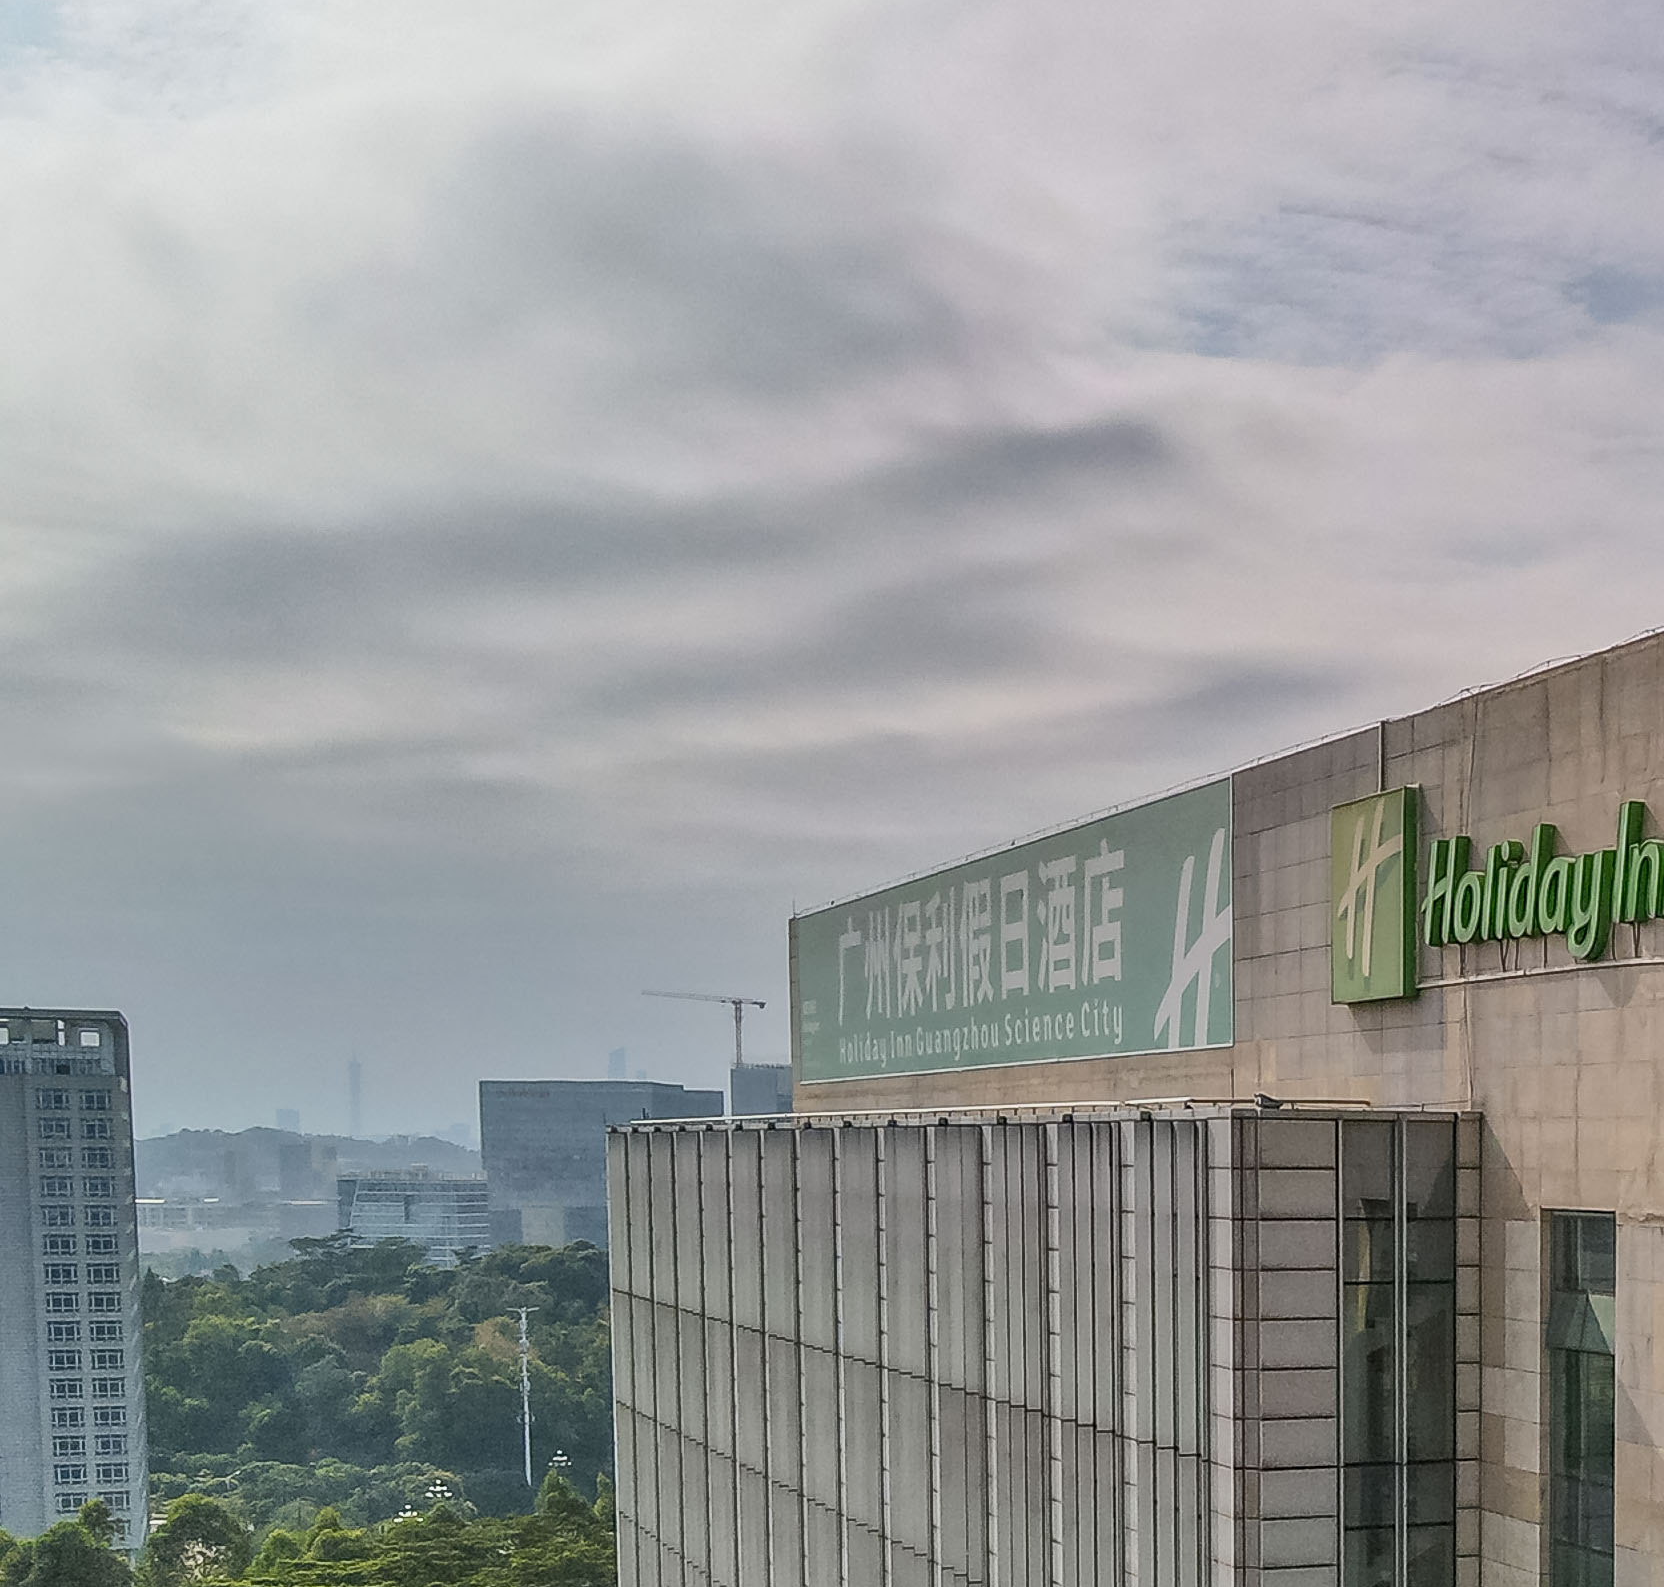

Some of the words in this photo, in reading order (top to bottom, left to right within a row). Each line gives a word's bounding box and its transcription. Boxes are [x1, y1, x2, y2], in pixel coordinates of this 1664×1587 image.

[838, 838, 1125, 1026] 广州保利假日酒店
[1421, 822, 1617, 960] Holiday
[839, 1031, 887, 1068] Holiday
[890, 1030, 913, 1059] Inn
[915, 1016, 999, 1061] Guangzhou
[1004, 1007, 1075, 1046] Science
[1080, 999, 1124, 1045] City
